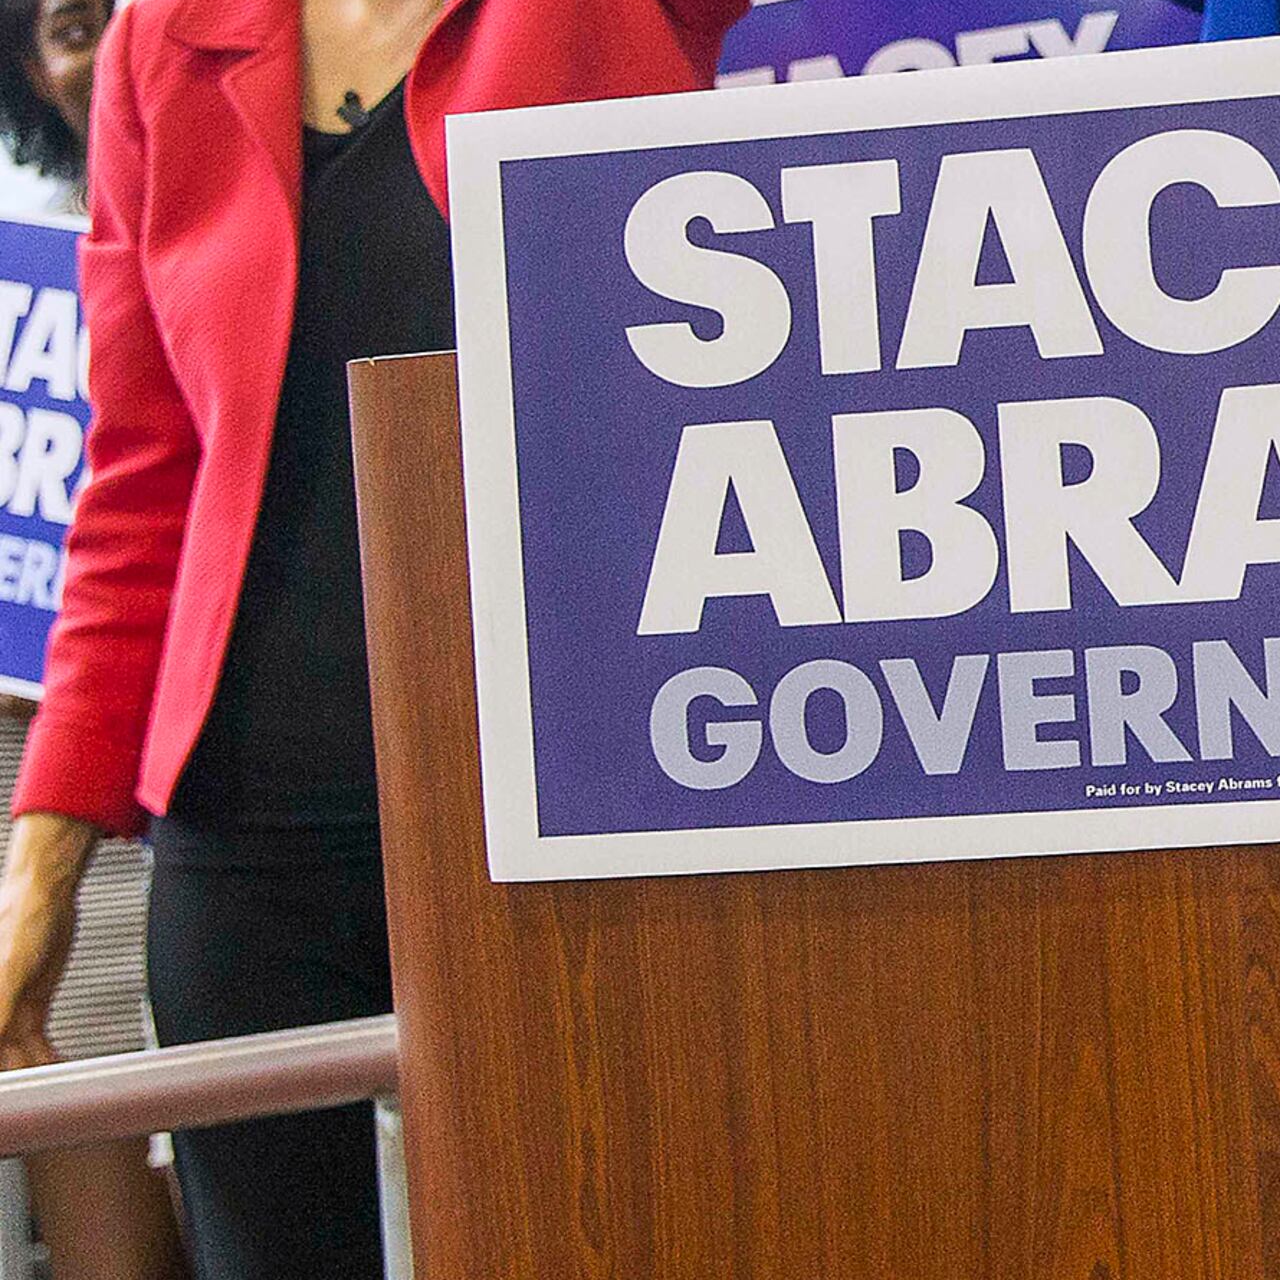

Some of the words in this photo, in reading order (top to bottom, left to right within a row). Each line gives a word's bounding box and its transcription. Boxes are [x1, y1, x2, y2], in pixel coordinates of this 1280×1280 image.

[1085, 783, 1117, 798] Paid
[1119, 782, 1141, 797] for
[1144, 782, 1163, 797] by
[1165, 780, 1215, 795] Stacey
[1217, 776, 1273, 791] Abrams
